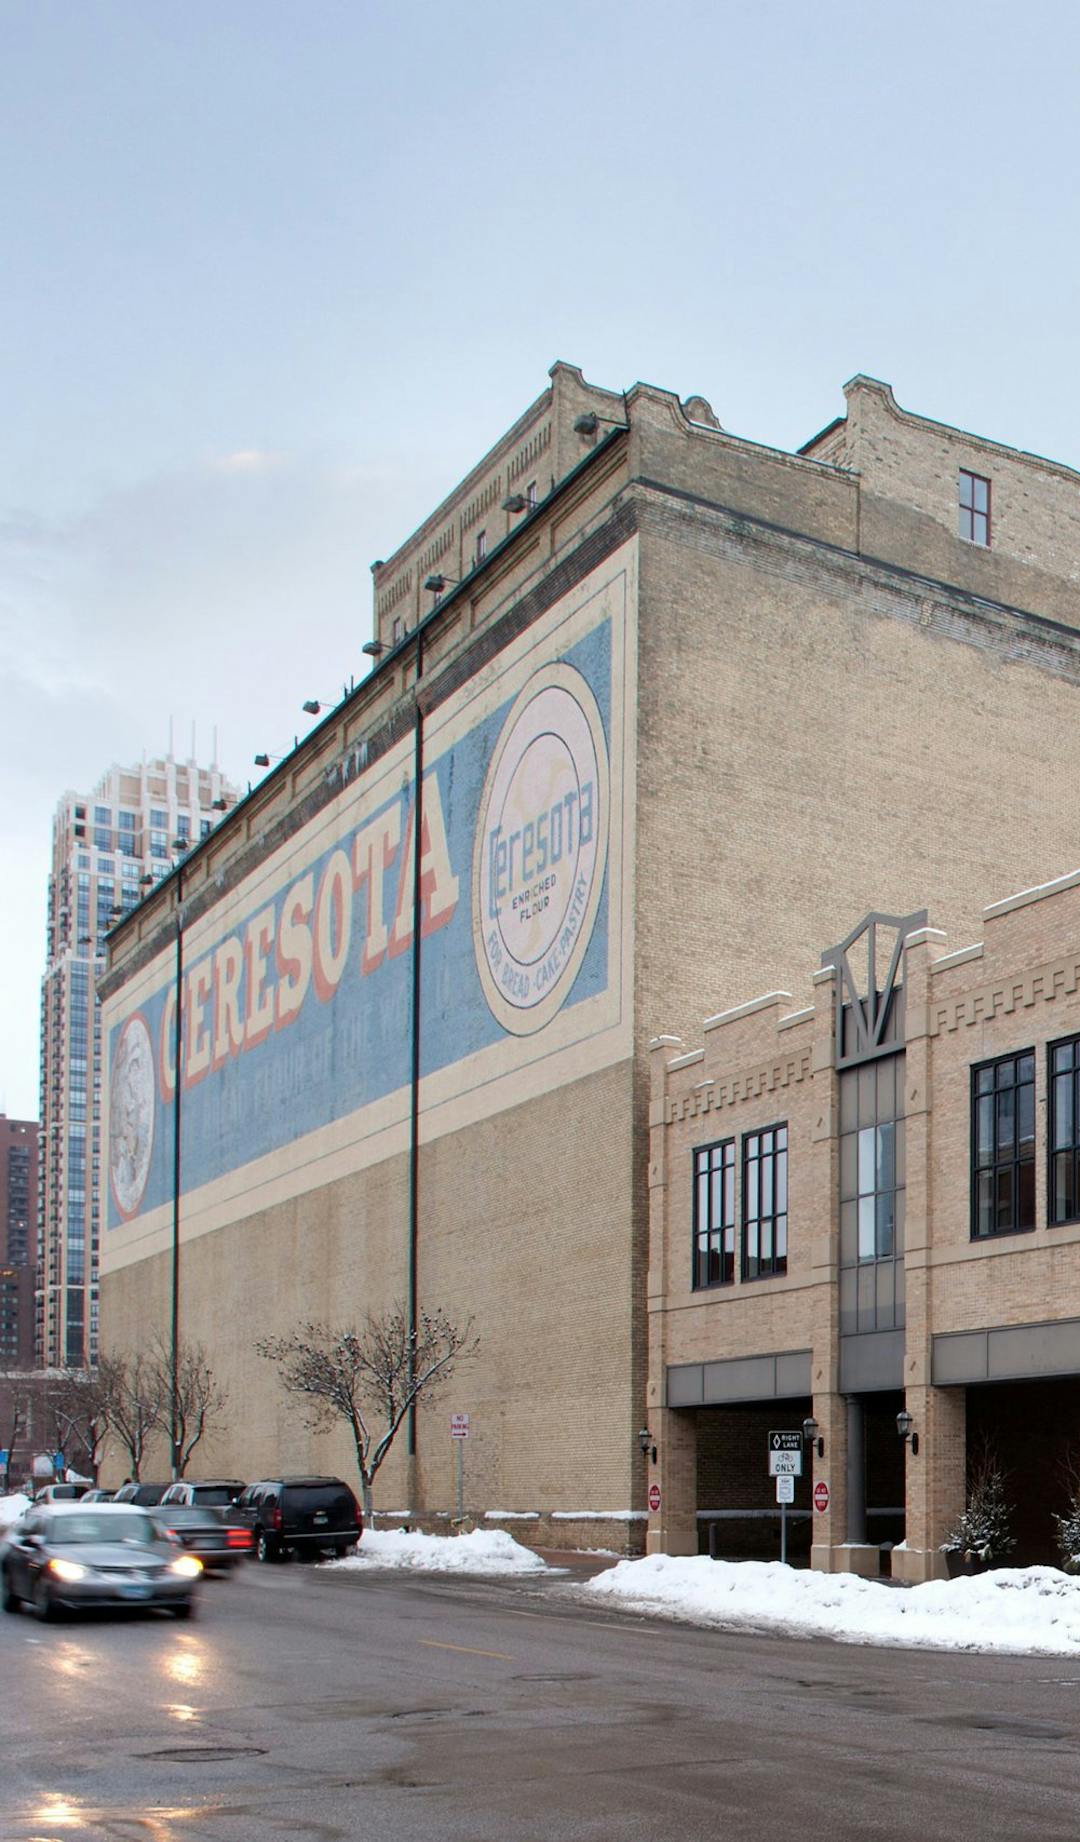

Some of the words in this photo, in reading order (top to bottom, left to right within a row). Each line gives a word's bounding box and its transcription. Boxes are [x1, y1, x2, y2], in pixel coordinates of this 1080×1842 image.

[512, 874, 557, 910] ENRCHED
[520, 895, 550, 923] FLOUR
[160, 771, 459, 1104] CERESOTA
[775, 1463, 795, 1473] ONLY
